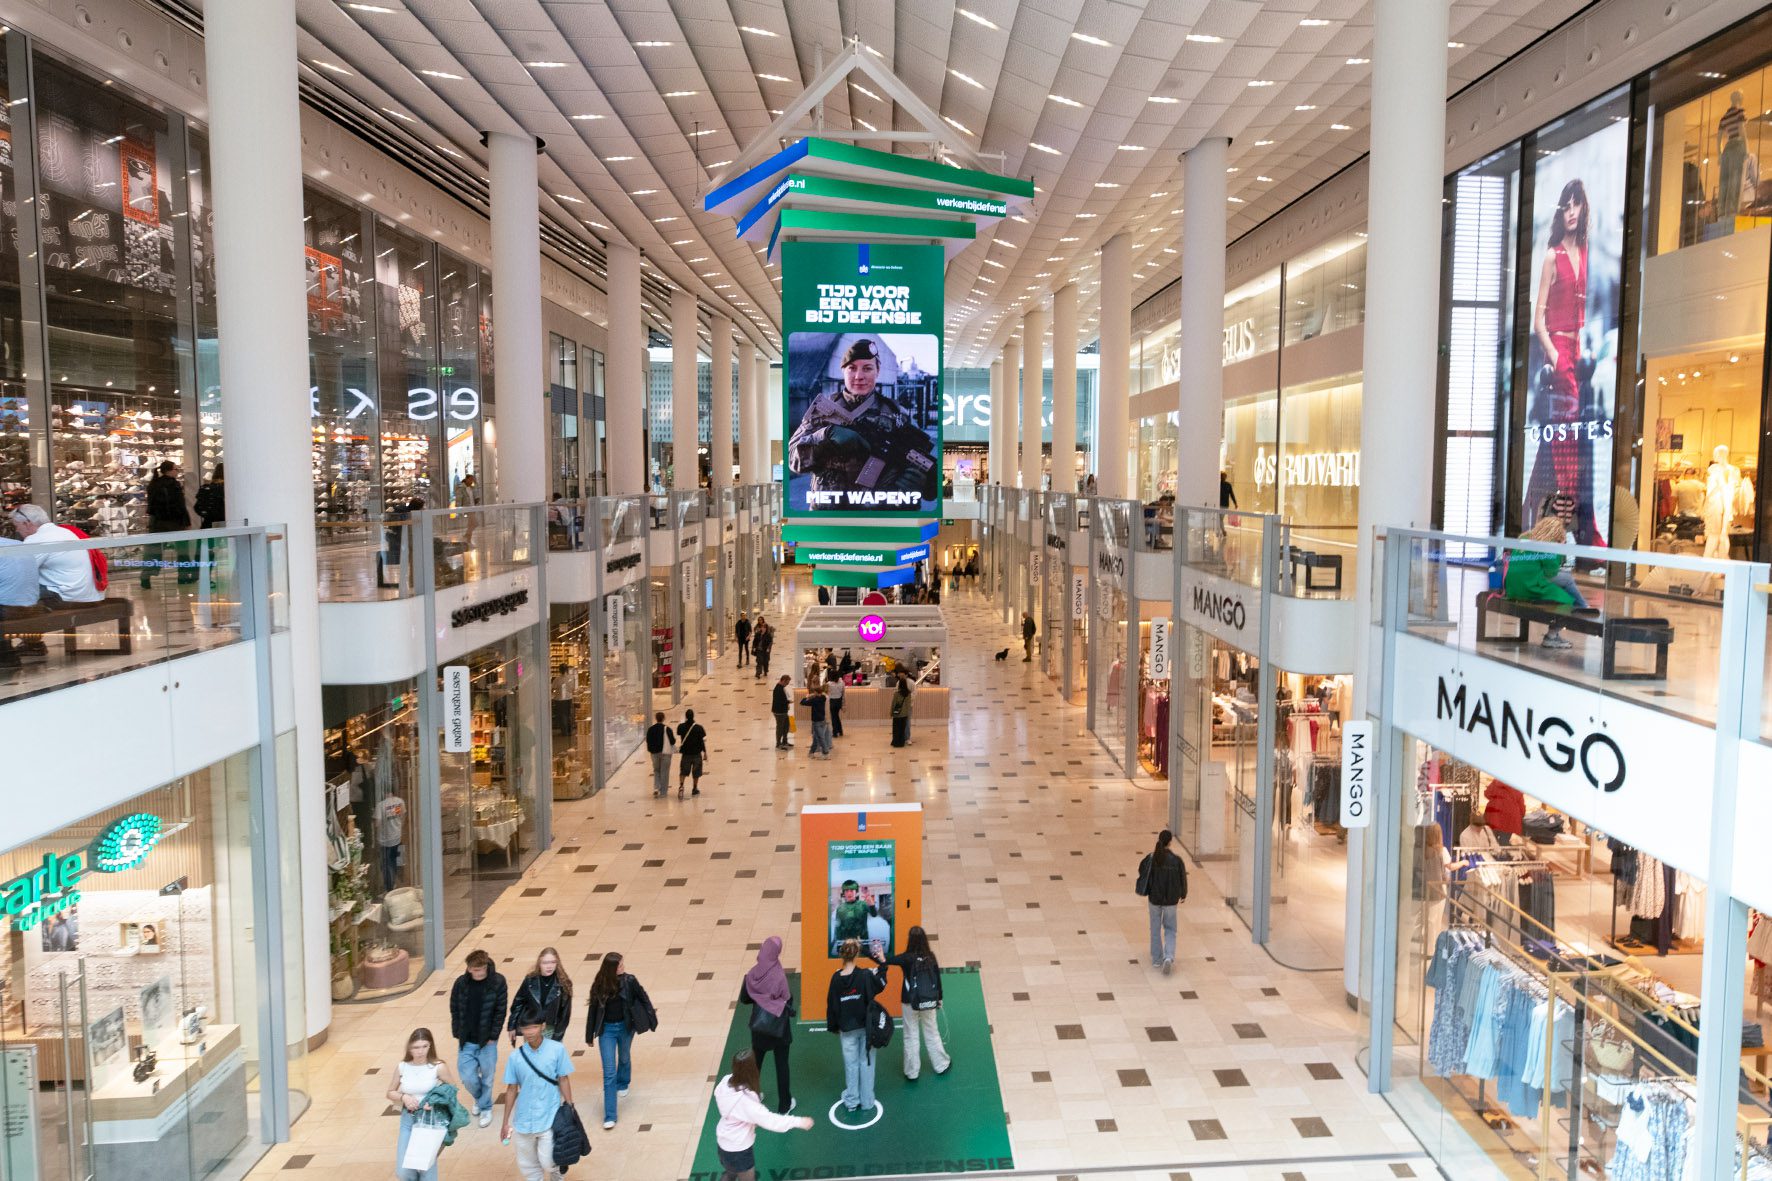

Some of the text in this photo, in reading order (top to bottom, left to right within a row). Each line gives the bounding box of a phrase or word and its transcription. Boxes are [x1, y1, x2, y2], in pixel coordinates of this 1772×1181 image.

[817, 284, 910, 299] TIJD VOOR
[819, 297, 908, 312] EEN BAAN
[805, 309, 922, 325] BIJ DEFENSIE
[1529, 419, 1613, 442] COSTES
[805, 490, 922, 505] MET WAPEN?
[808, 552, 884, 563] werkenbijdefensie.nl
[1075, 579, 1083, 615] MANGO
[1193, 585, 1246, 631] MANGO
[860, 620, 884, 635] YO!
[1154, 623, 1165, 674] MANGO
[452, 671, 462, 748] SØSTRENE GRENE
[1436, 675, 1627, 793] MANGO
[1349, 733, 1365, 817] MANGO
[0, 853, 82, 916] arle
